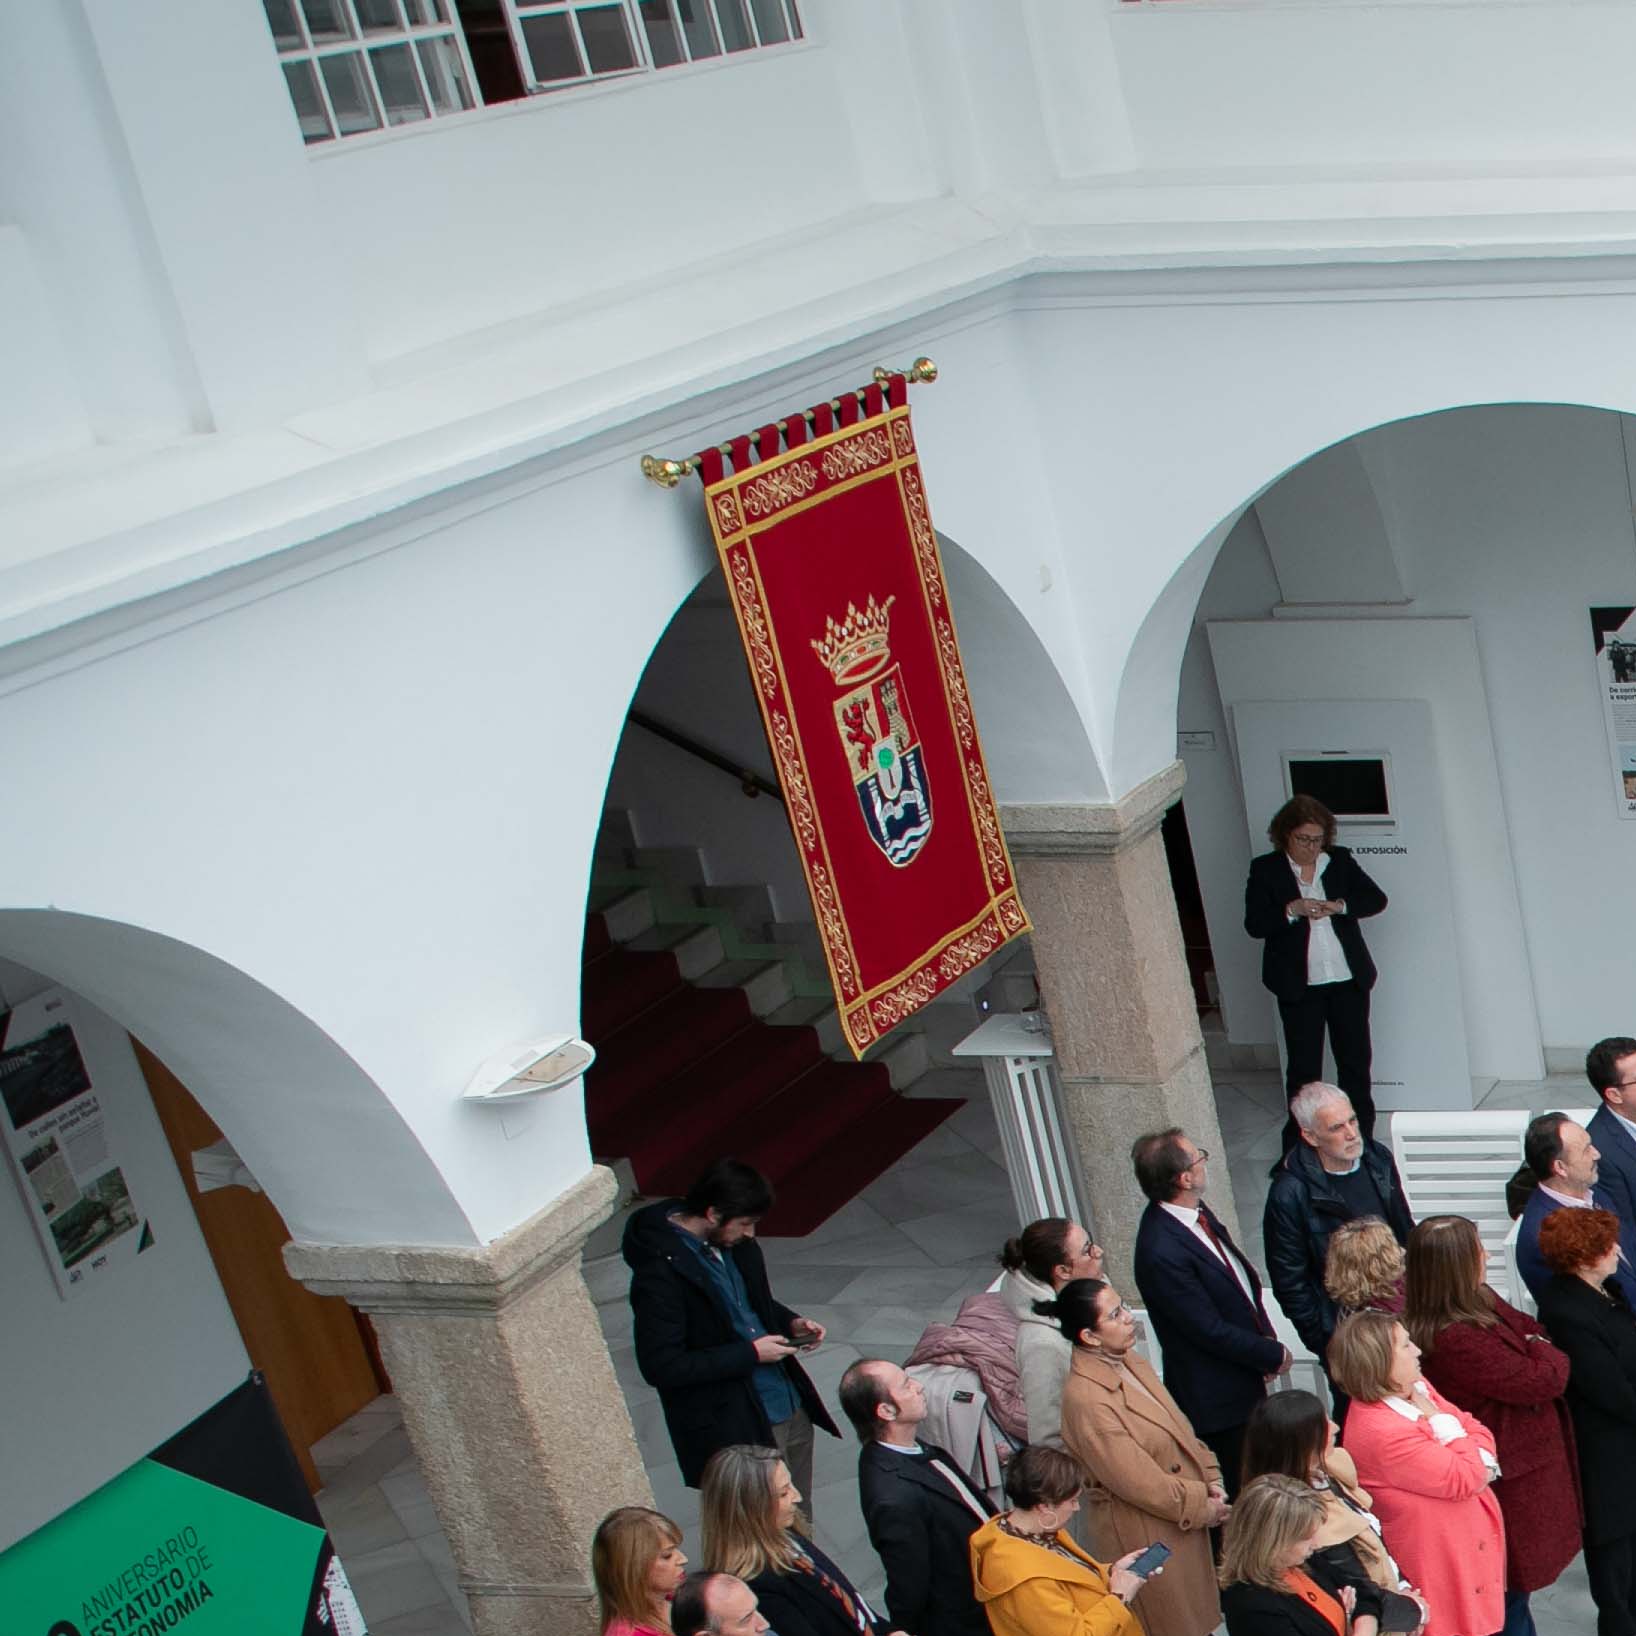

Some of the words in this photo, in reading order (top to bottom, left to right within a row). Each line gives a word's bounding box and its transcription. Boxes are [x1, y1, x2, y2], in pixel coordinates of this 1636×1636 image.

[1357, 844, 1408, 854] EXPOSICIÓN
[81, 1526, 199, 1626] ANIVERSARIO
[185, 1545, 214, 1579] DE
